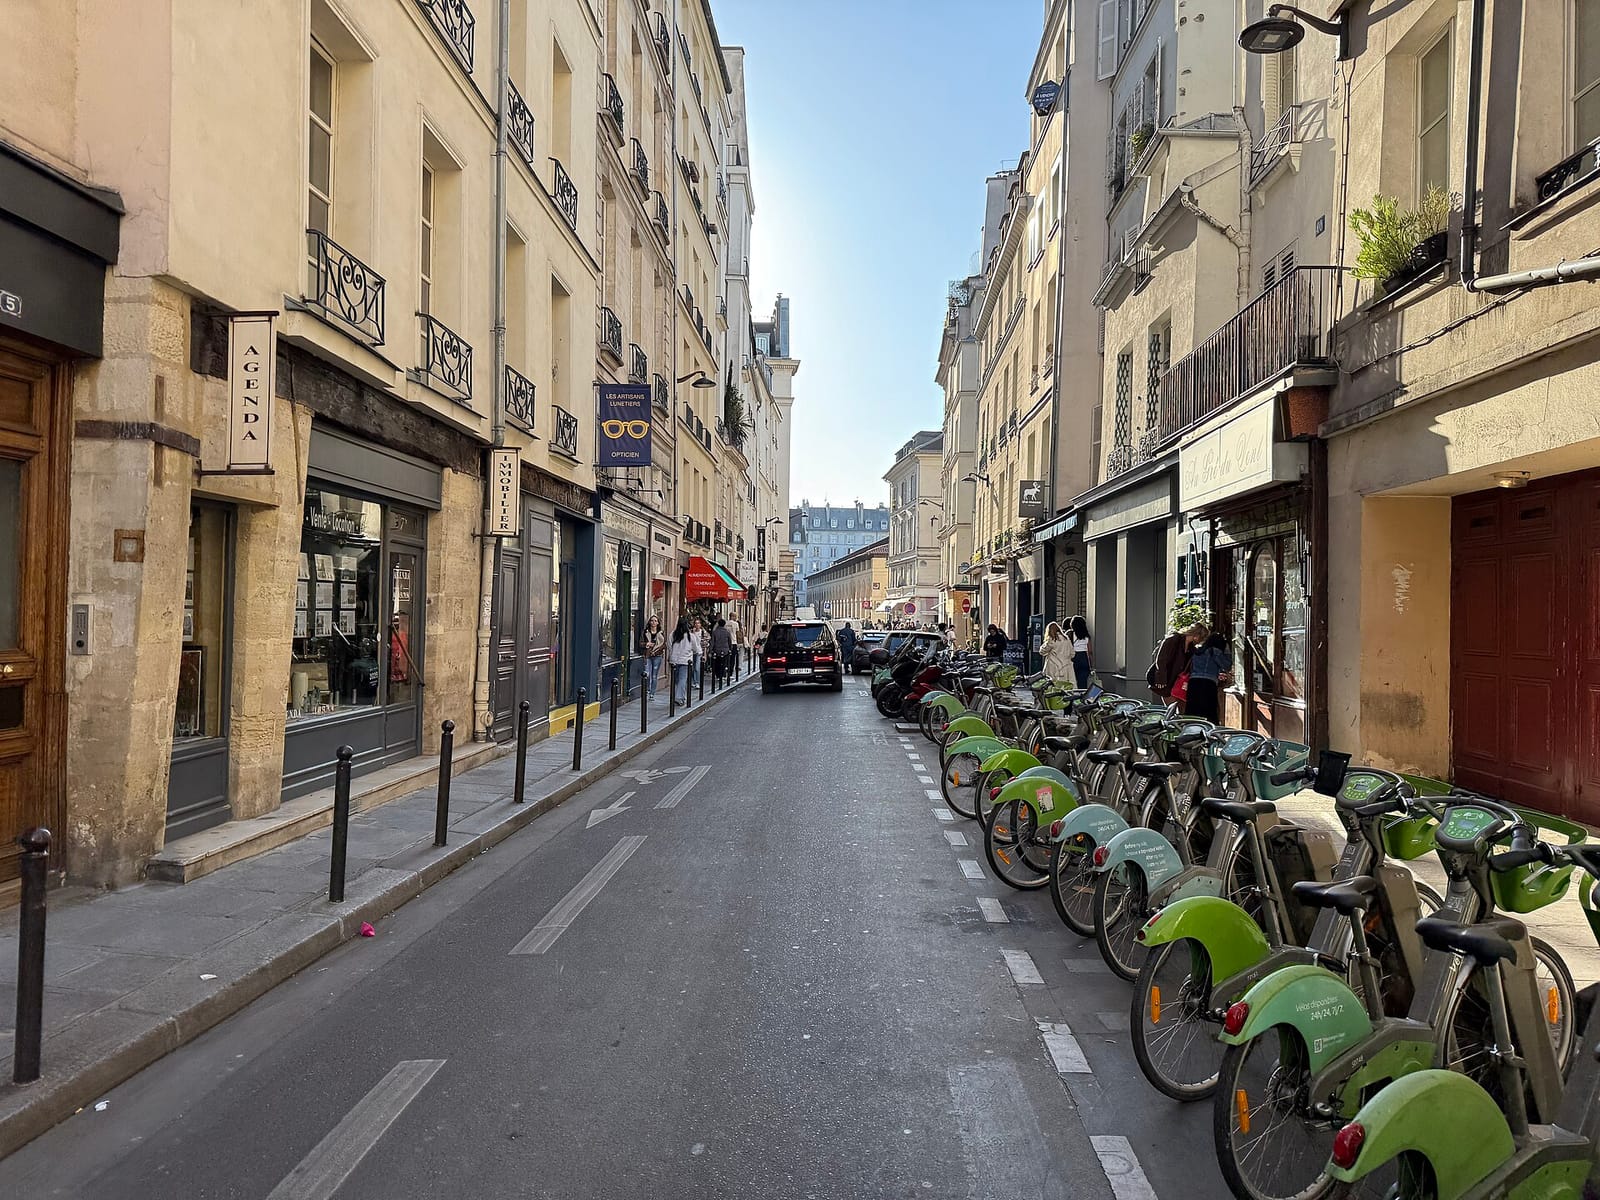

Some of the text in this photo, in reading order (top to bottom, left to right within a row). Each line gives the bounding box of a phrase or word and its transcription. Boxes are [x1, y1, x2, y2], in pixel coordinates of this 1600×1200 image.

[6, 296, 15, 311] 5
[243, 345, 260, 441] AGENDA
[499, 455, 512, 530] IMMOBILIER
[310, 506, 355, 534] Vente Location
